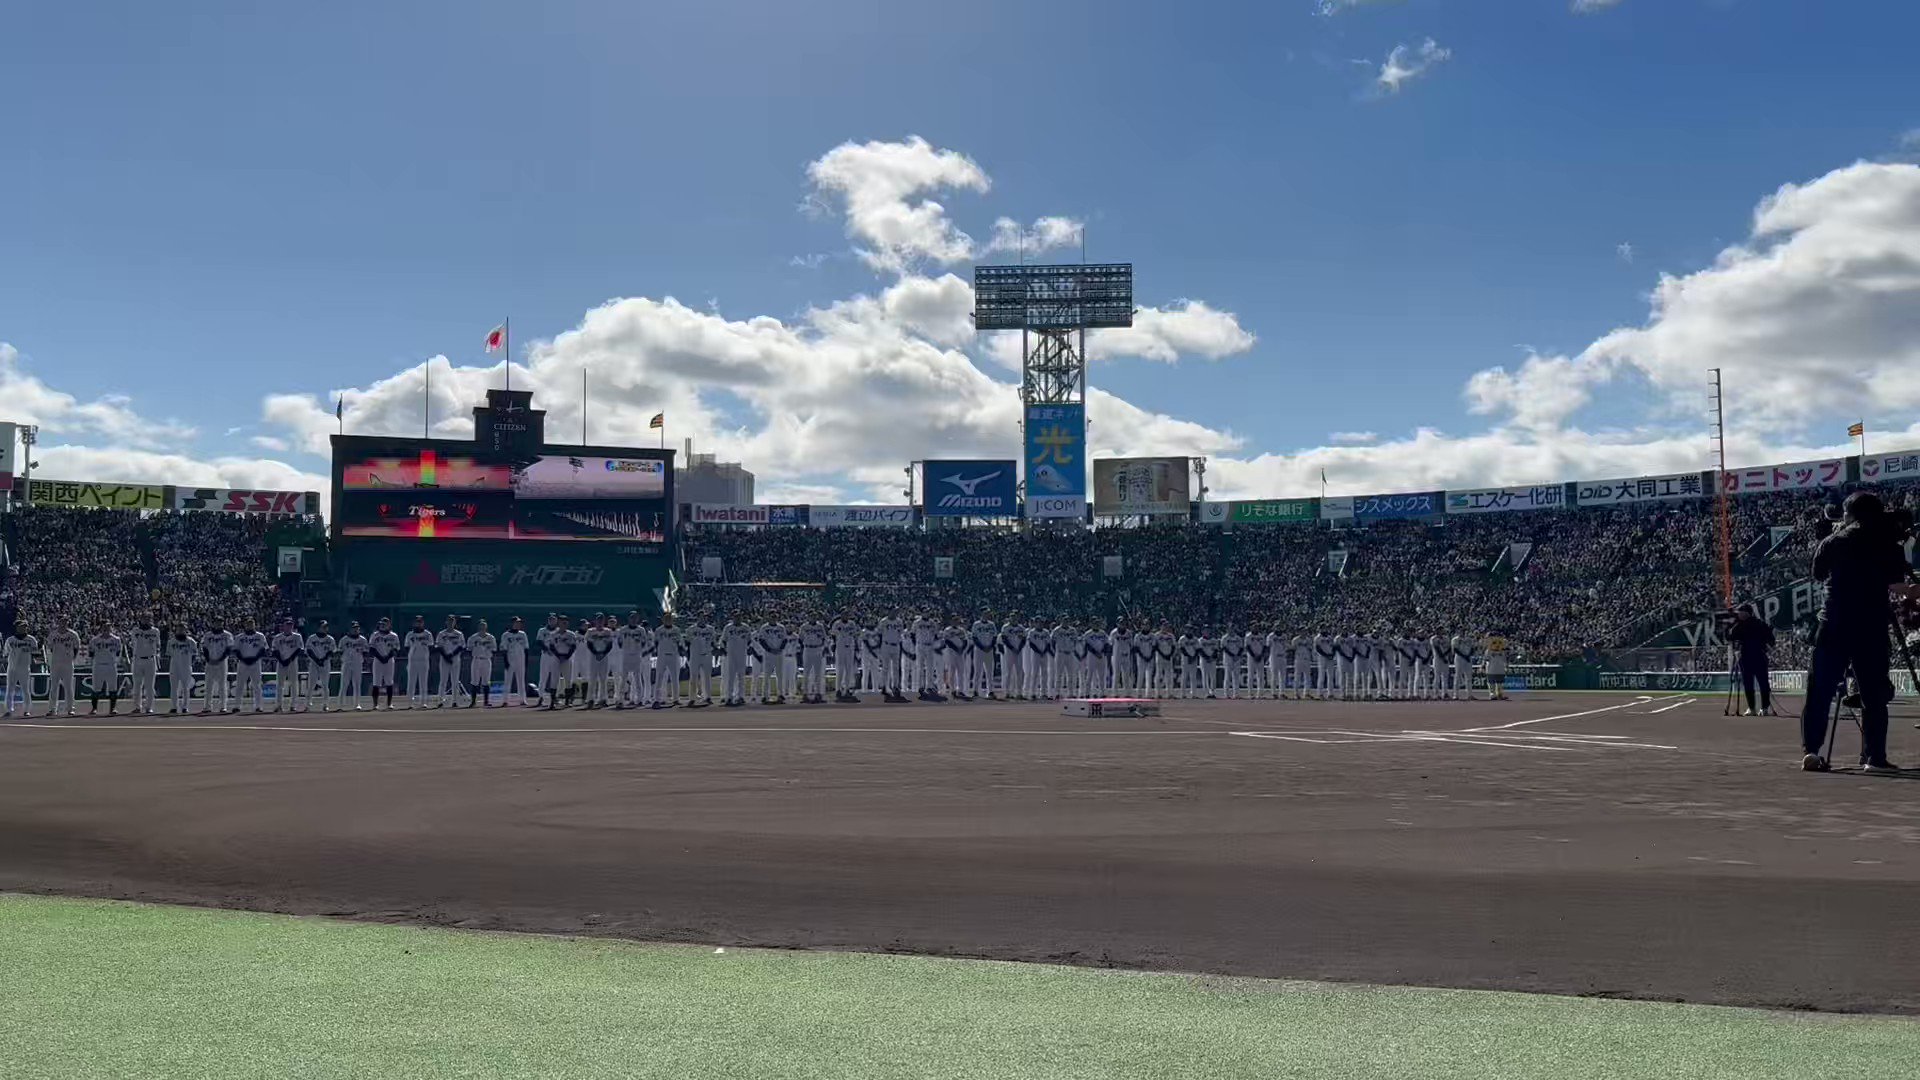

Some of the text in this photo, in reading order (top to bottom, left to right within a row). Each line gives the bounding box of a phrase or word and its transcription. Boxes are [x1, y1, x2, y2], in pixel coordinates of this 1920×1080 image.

[1032, 425, 1078, 464] 光
[1615, 475, 1700, 499] 大同工業
[1723, 461, 1841, 491] カニトップ
[29, 481, 161, 508] 関西ペイント
[223, 491, 300, 513] SSK
[1355, 495, 1431, 513] シスメックス
[1468, 485, 1563, 508] エスケー化研
[696, 506, 766, 521] iwatani
[1034, 500, 1077, 513] J:COM
[1241, 503, 1304, 517] りそな銀行
